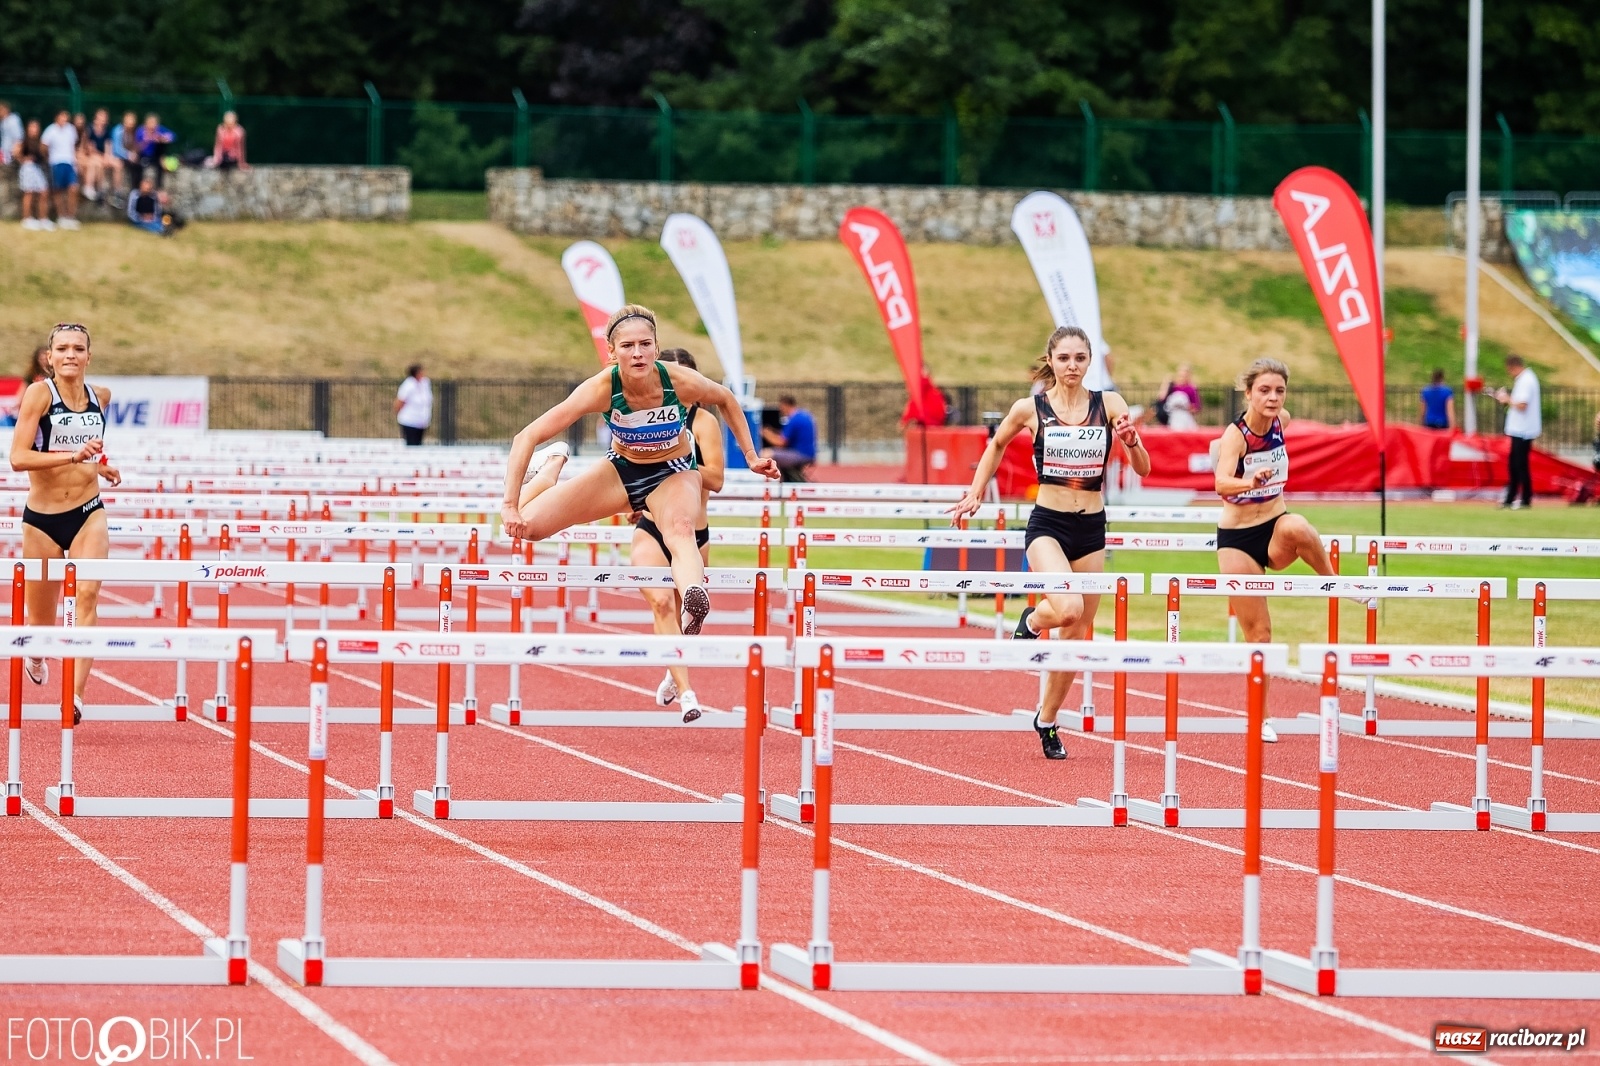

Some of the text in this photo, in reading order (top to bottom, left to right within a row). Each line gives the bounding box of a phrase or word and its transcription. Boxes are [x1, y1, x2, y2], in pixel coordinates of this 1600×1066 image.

[80, 415, 101, 426] 152
[647, 408, 677, 424] 246
[1078, 429, 1103, 440] 297
[1046, 447, 1103, 459] SKIERKOWSKA
[1271, 448, 1286, 463] 364
[1050, 469, 1081, 477] RACIBÓRZ
[214, 565, 266, 579] polanik
[519, 573, 547, 581] ORLEN
